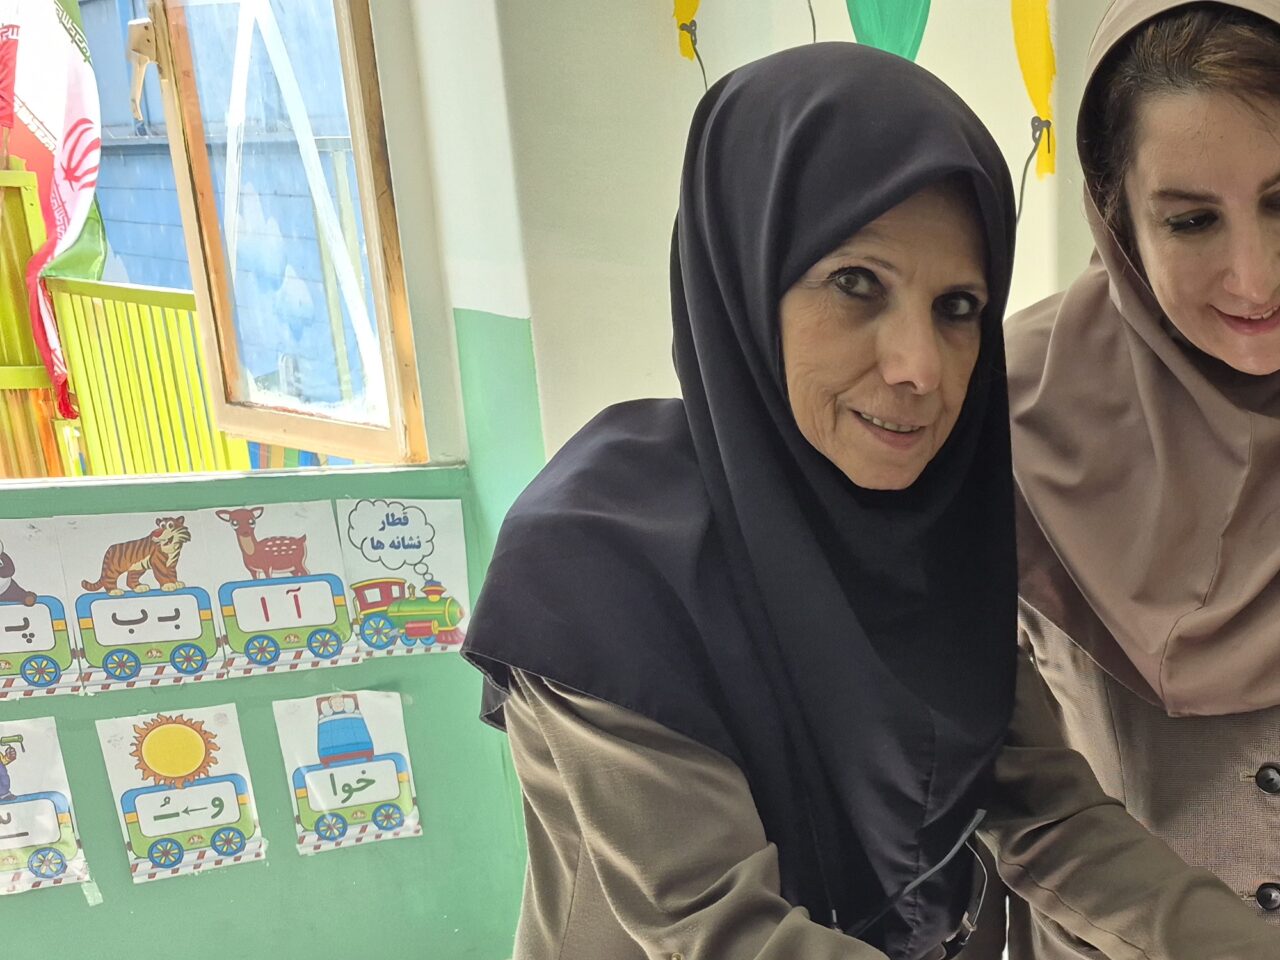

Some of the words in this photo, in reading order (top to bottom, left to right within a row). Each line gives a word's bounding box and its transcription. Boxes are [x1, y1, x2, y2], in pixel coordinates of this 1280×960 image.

[378, 511, 409, 531] قطار
[370, 536, 385, 550] ها
[389, 535, 422, 550] نشانه
[286, 586, 302, 619] آ
[111, 608, 149, 634] ب
[329, 770, 376, 803] خوا
